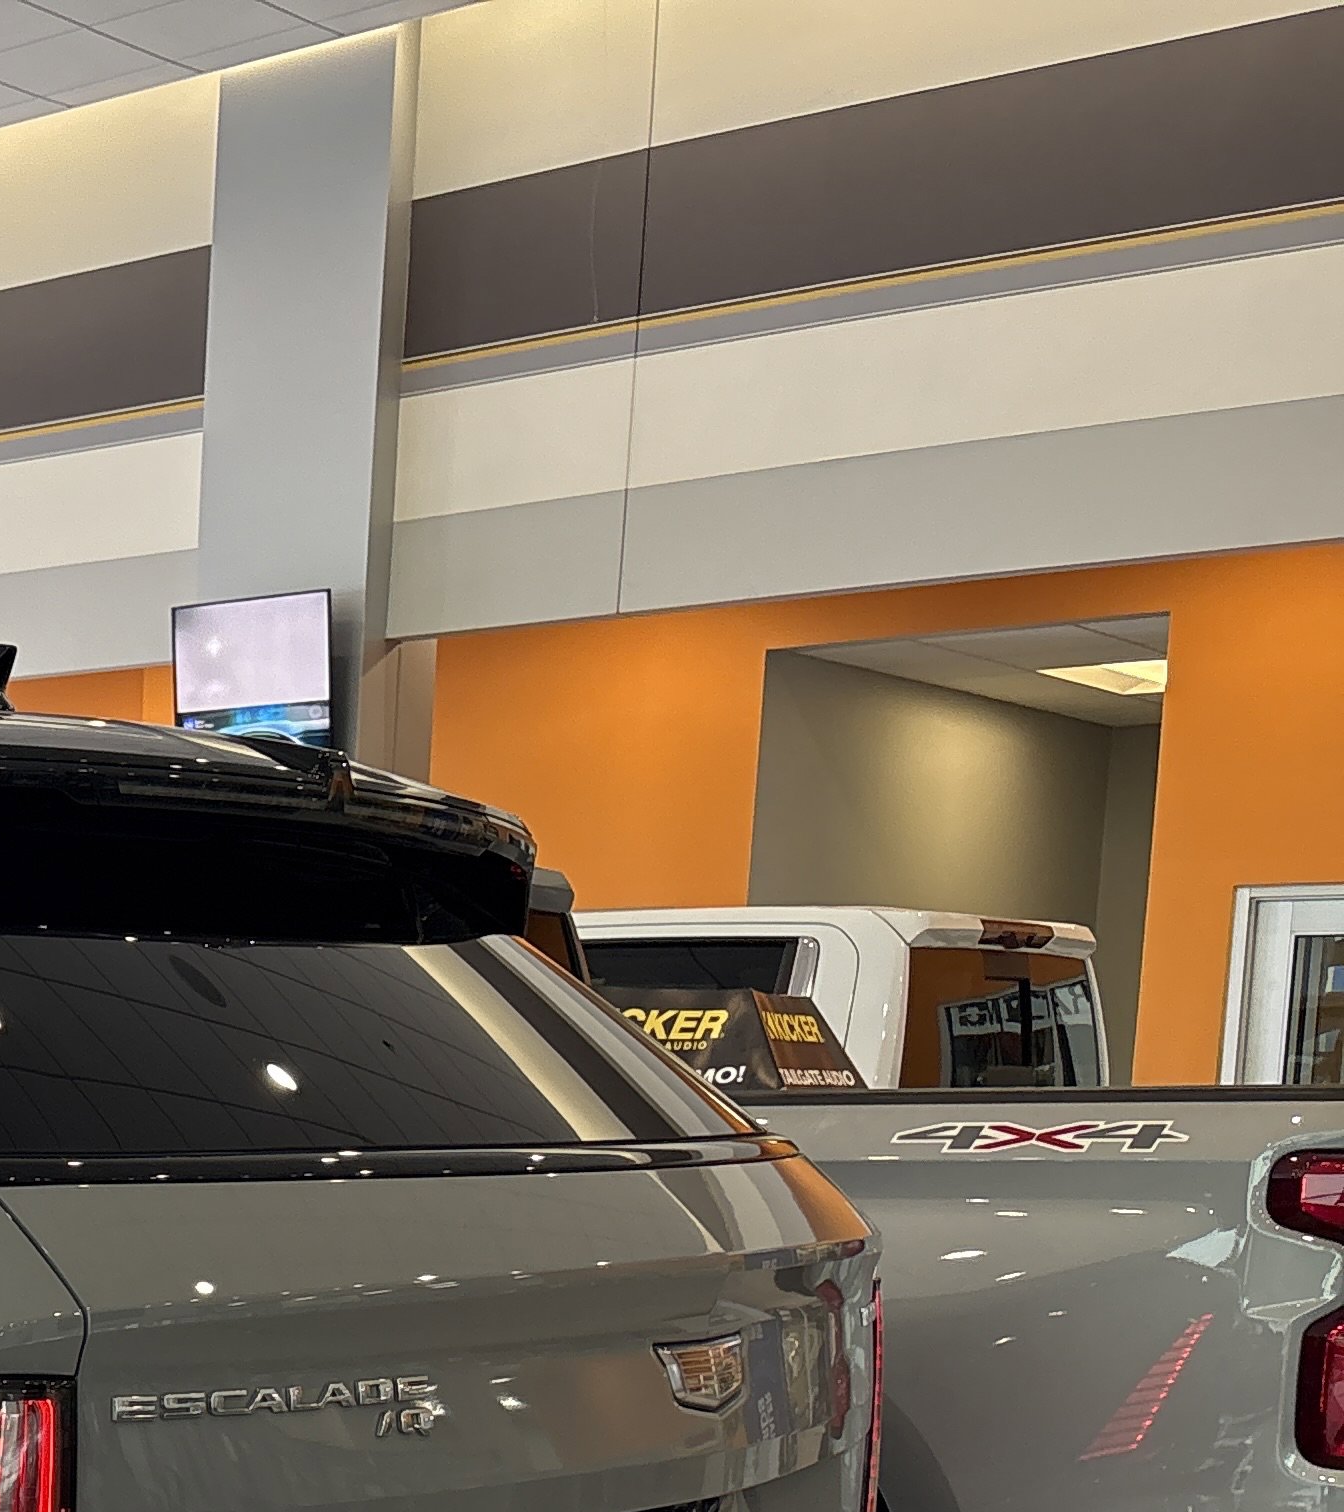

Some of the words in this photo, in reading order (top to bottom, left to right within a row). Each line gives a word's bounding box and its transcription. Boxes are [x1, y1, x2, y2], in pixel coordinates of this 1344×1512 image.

[664, 1040, 708, 1051] AUDIO
[779, 1068, 824, 1086] TAILGATE
[823, 1070, 855, 1087] AUDIO
[110, 1374, 432, 1423] ESCALADE
